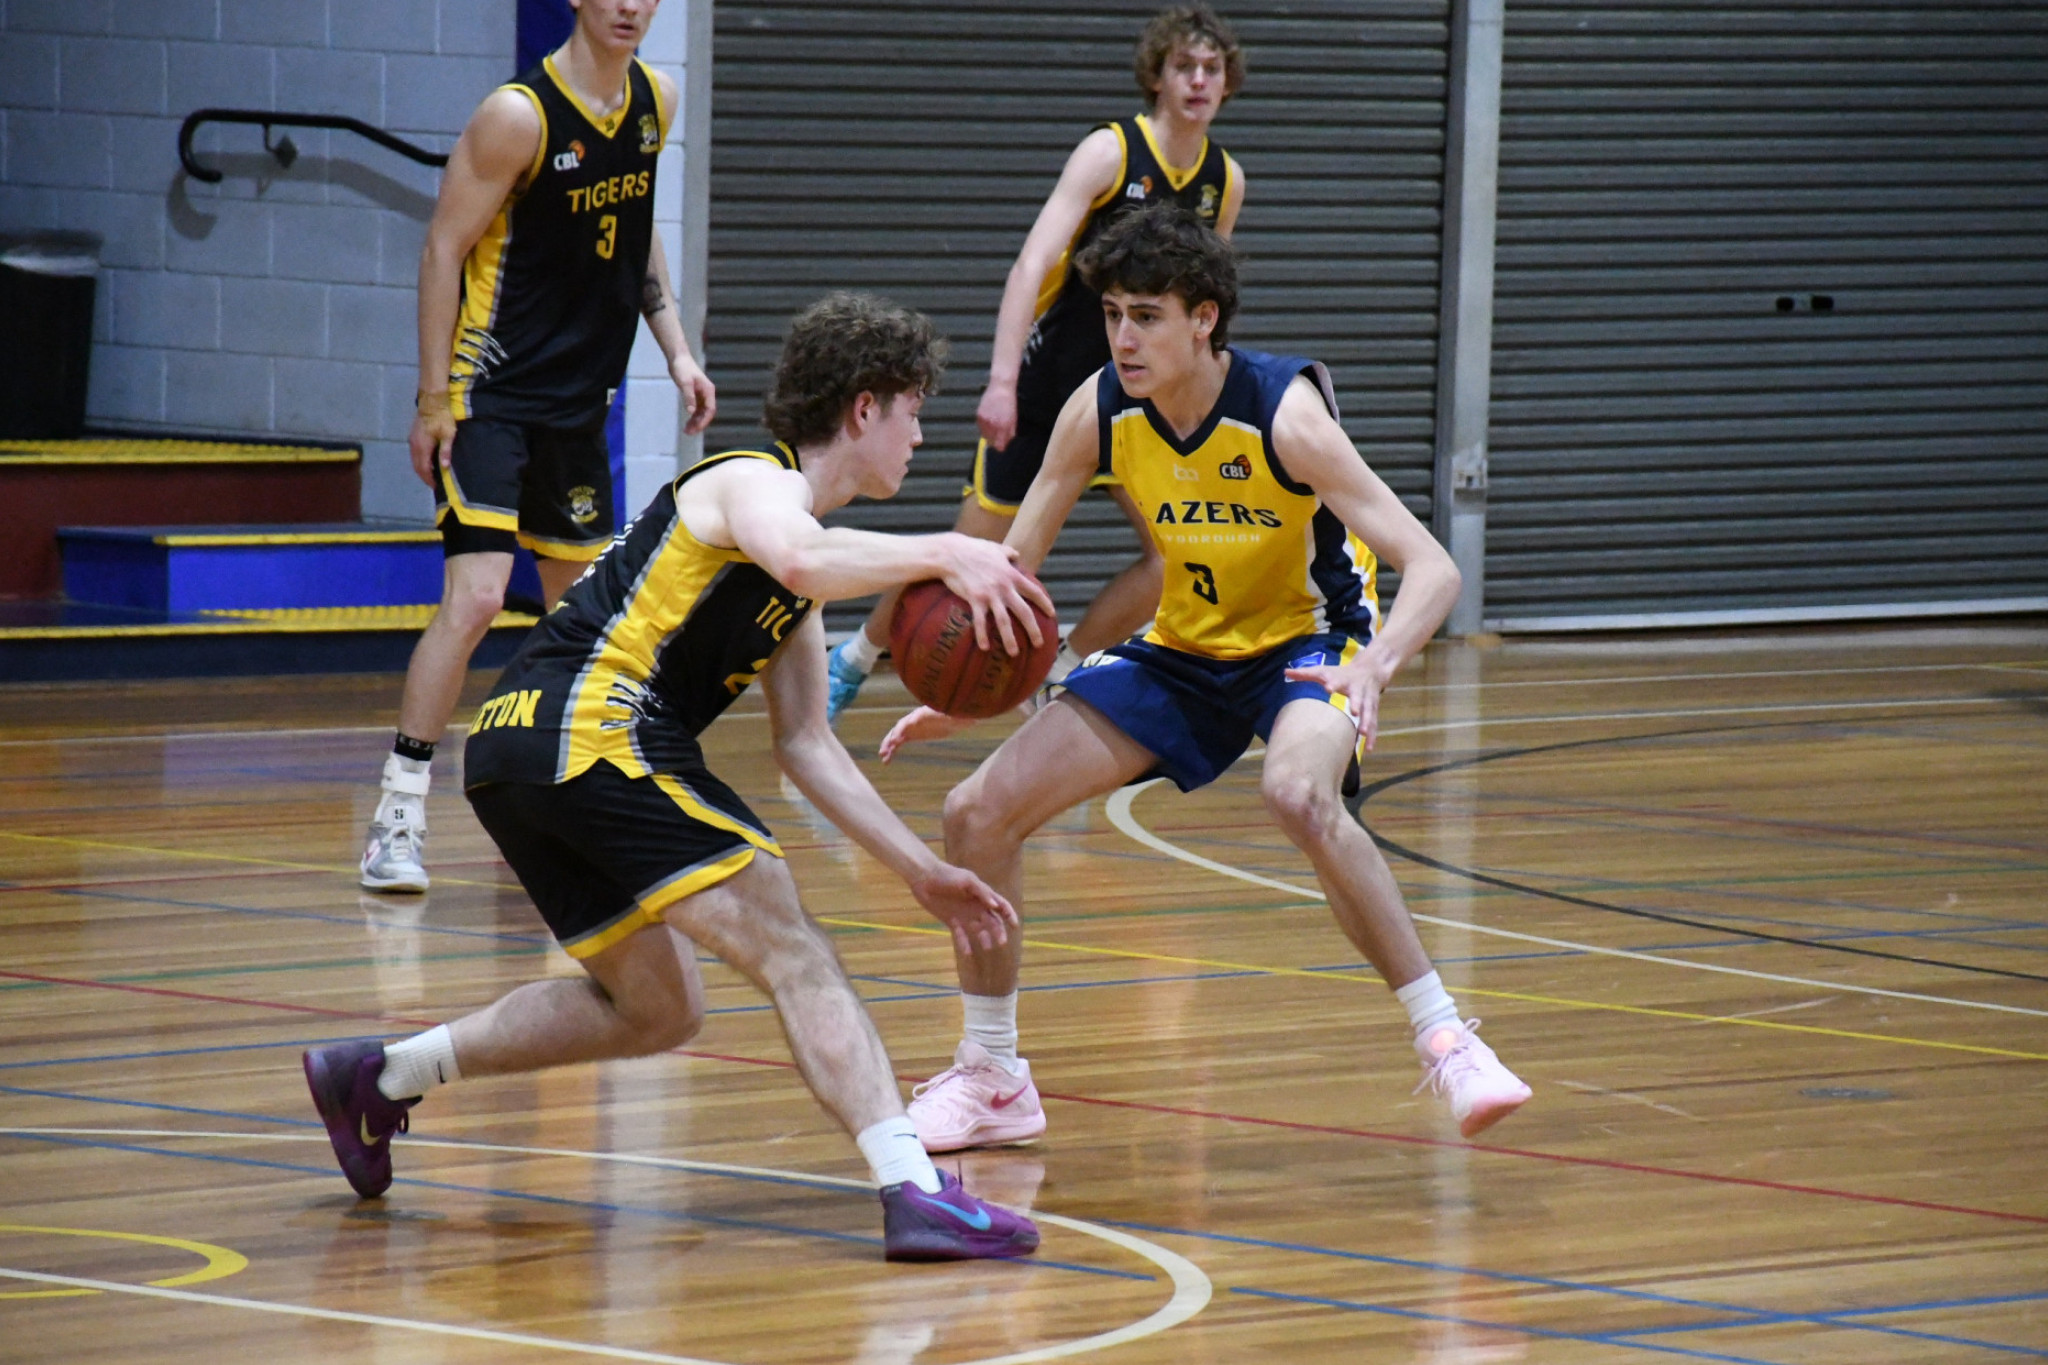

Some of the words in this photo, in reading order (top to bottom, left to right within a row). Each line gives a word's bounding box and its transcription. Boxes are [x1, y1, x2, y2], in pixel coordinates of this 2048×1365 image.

[553, 152, 580, 171] CBL
[566, 171, 649, 213] TIGERS
[596, 215, 617, 260] 3
[1221, 464, 1247, 479] CBL
[1156, 501, 1282, 528] AZERS
[1184, 561, 1219, 606] 3
